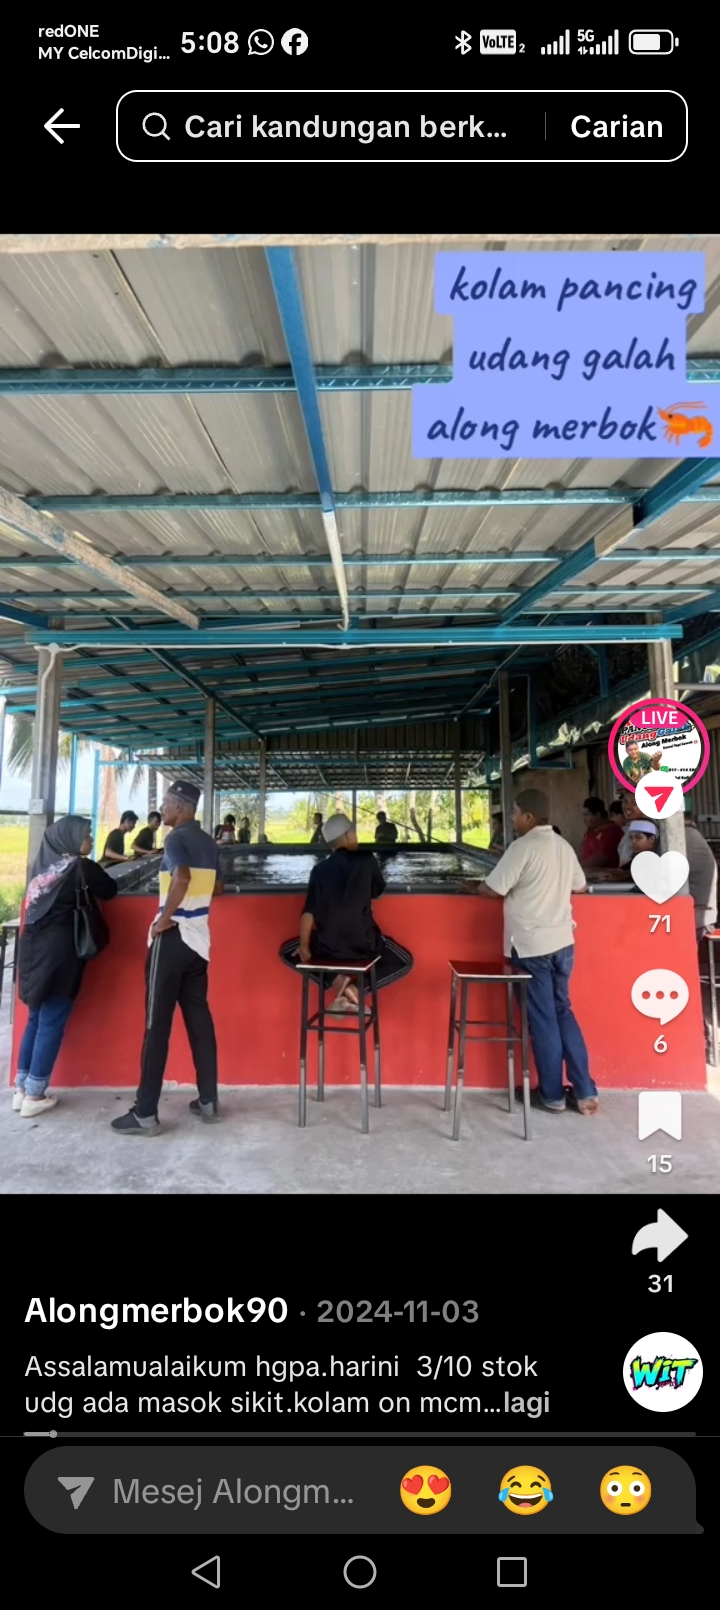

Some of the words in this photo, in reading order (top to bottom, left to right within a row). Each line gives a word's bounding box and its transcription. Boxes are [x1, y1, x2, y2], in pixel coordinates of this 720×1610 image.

[39, 24, 99, 38] redONE
[577, 28, 595, 42] 5G
[180, 31, 240, 54] 5:08
[482, 35, 515, 49] VoLTE
[39, 46, 64, 60] MY
[68, 45, 171, 63] CelcomDigi...
[184, 114, 242, 139] Cari
[252, 114, 410, 145] kandungan
[420, 114, 507, 139] berk...
[570, 114, 663, 139] Carian
[642, 711, 678, 725] LIVE
[641, 739, 661, 749] Along
[648, 914, 671, 933] 71
[653, 1034, 668, 1053] 6
[647, 1154, 672, 1173] 15
[647, 1274, 673, 1294] 31
[24, 1296, 288, 1329] Alongmerbok90
[317, 1301, 479, 1323] 2024-11-03
[24, 1354, 246, 1378] Assalamualaikum
[256, 1354, 399, 1383] hgpa.harini
[416, 1355, 472, 1381] 3/10
[481, 1354, 538, 1378] stok
[25, 1390, 73, 1419] udg
[82, 1390, 129, 1414] ada
[138, 1390, 222, 1414] masok
[230, 1390, 369, 1414] sikit.kolam
[378, 1396, 410, 1414] on
[114, 1477, 202, 1511] Mesej
[212, 1477, 354, 1511] Alongm...
